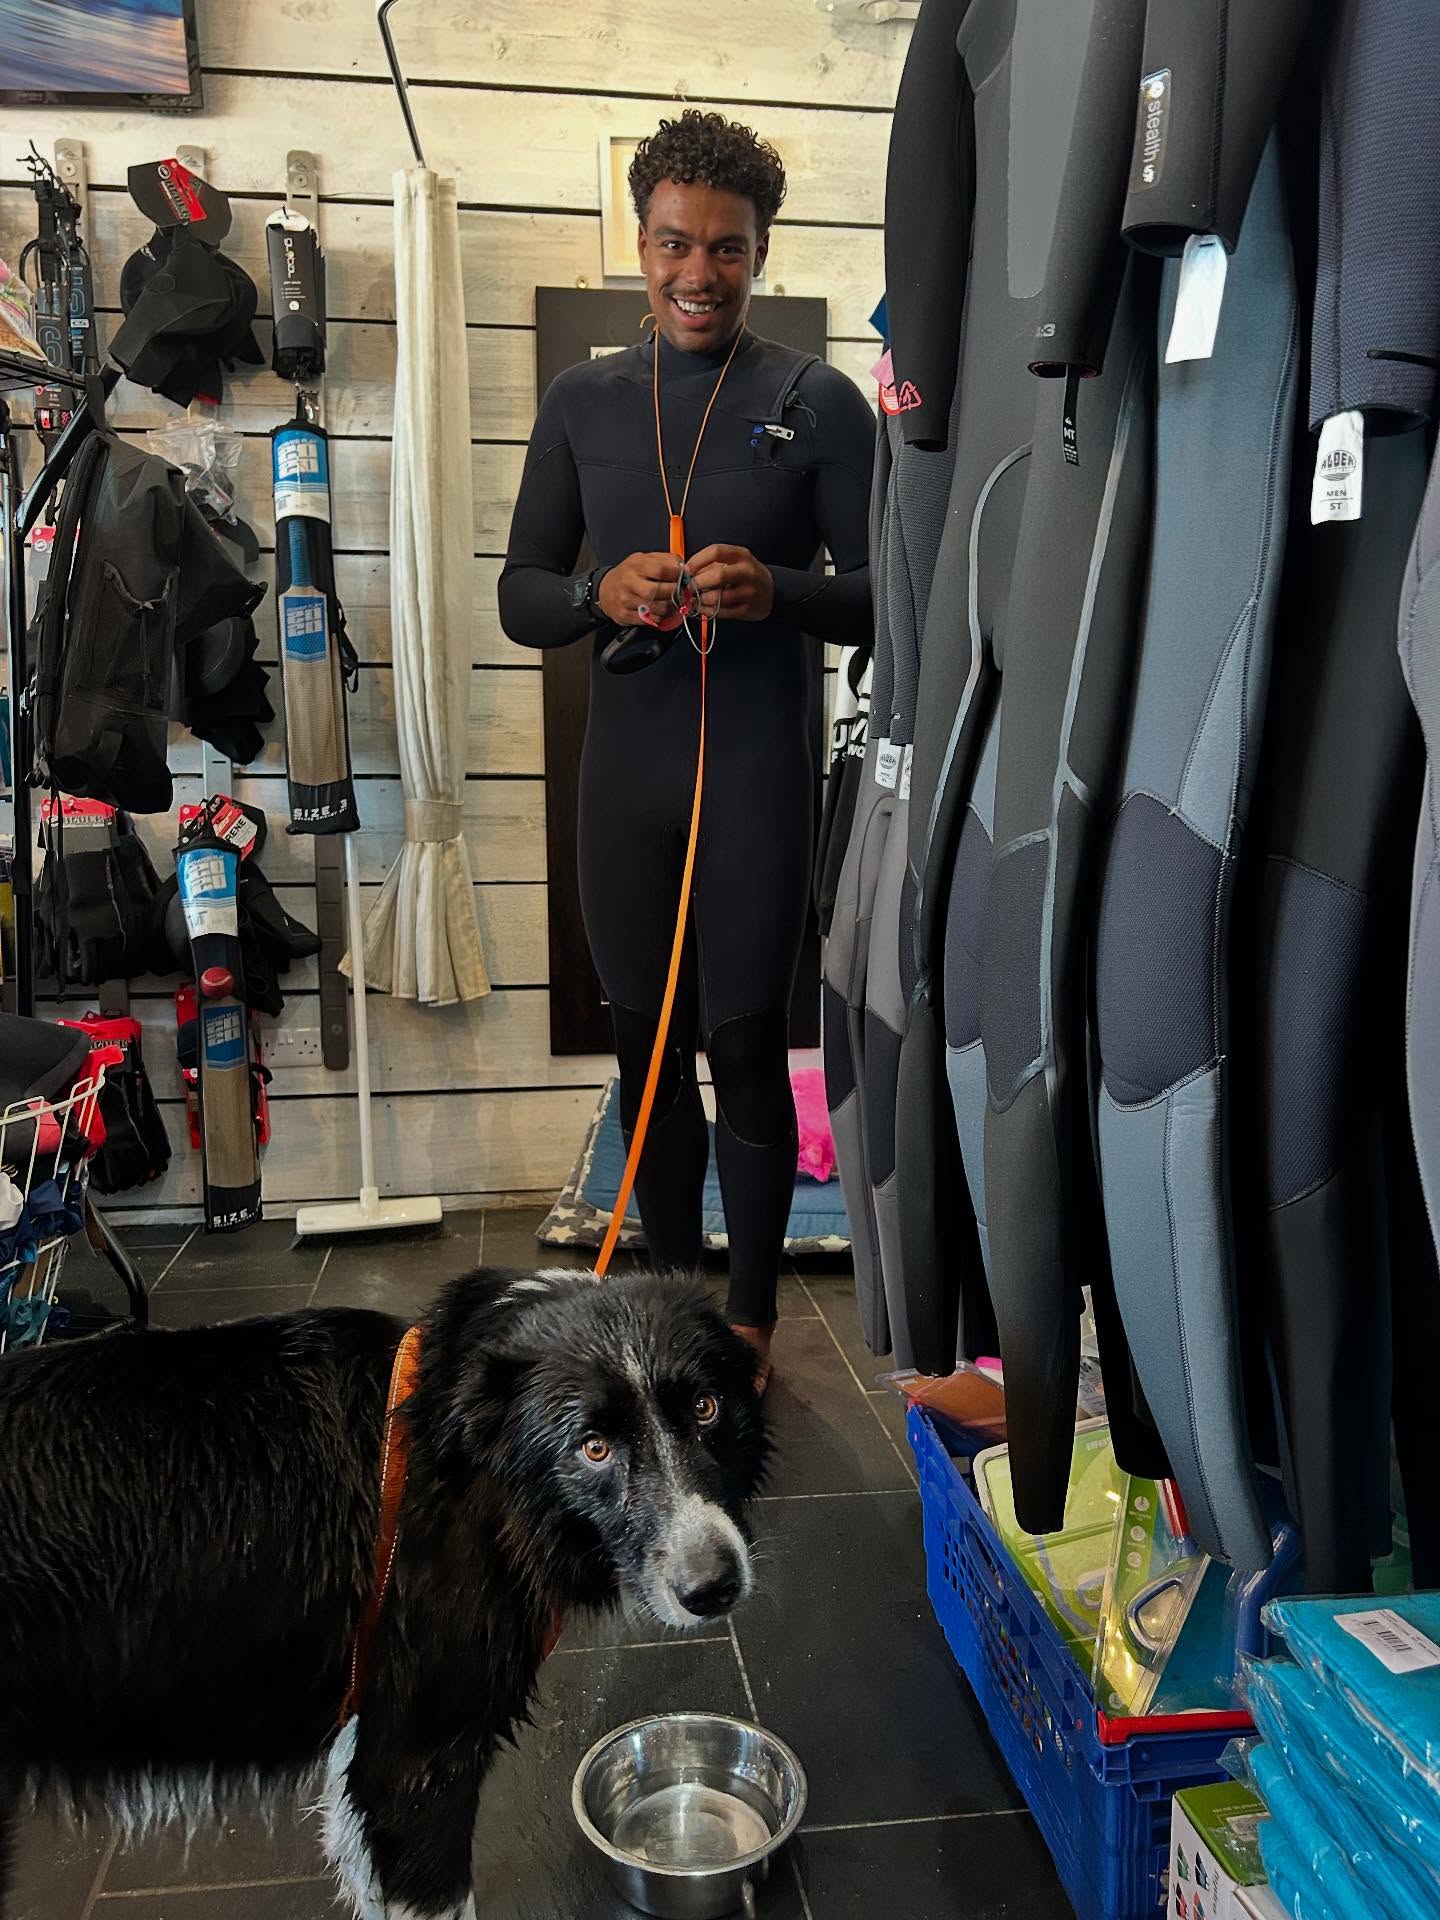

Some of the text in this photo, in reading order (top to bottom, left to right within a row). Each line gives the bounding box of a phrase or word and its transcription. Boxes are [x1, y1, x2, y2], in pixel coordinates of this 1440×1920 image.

[1143, 99, 1164, 163] stealth
[1326, 489, 1347, 497] MEN
[1330, 502, 1343, 511] ST
[294, 806, 330, 818] SIZE
[213, 1208, 248, 1224] SIZE
